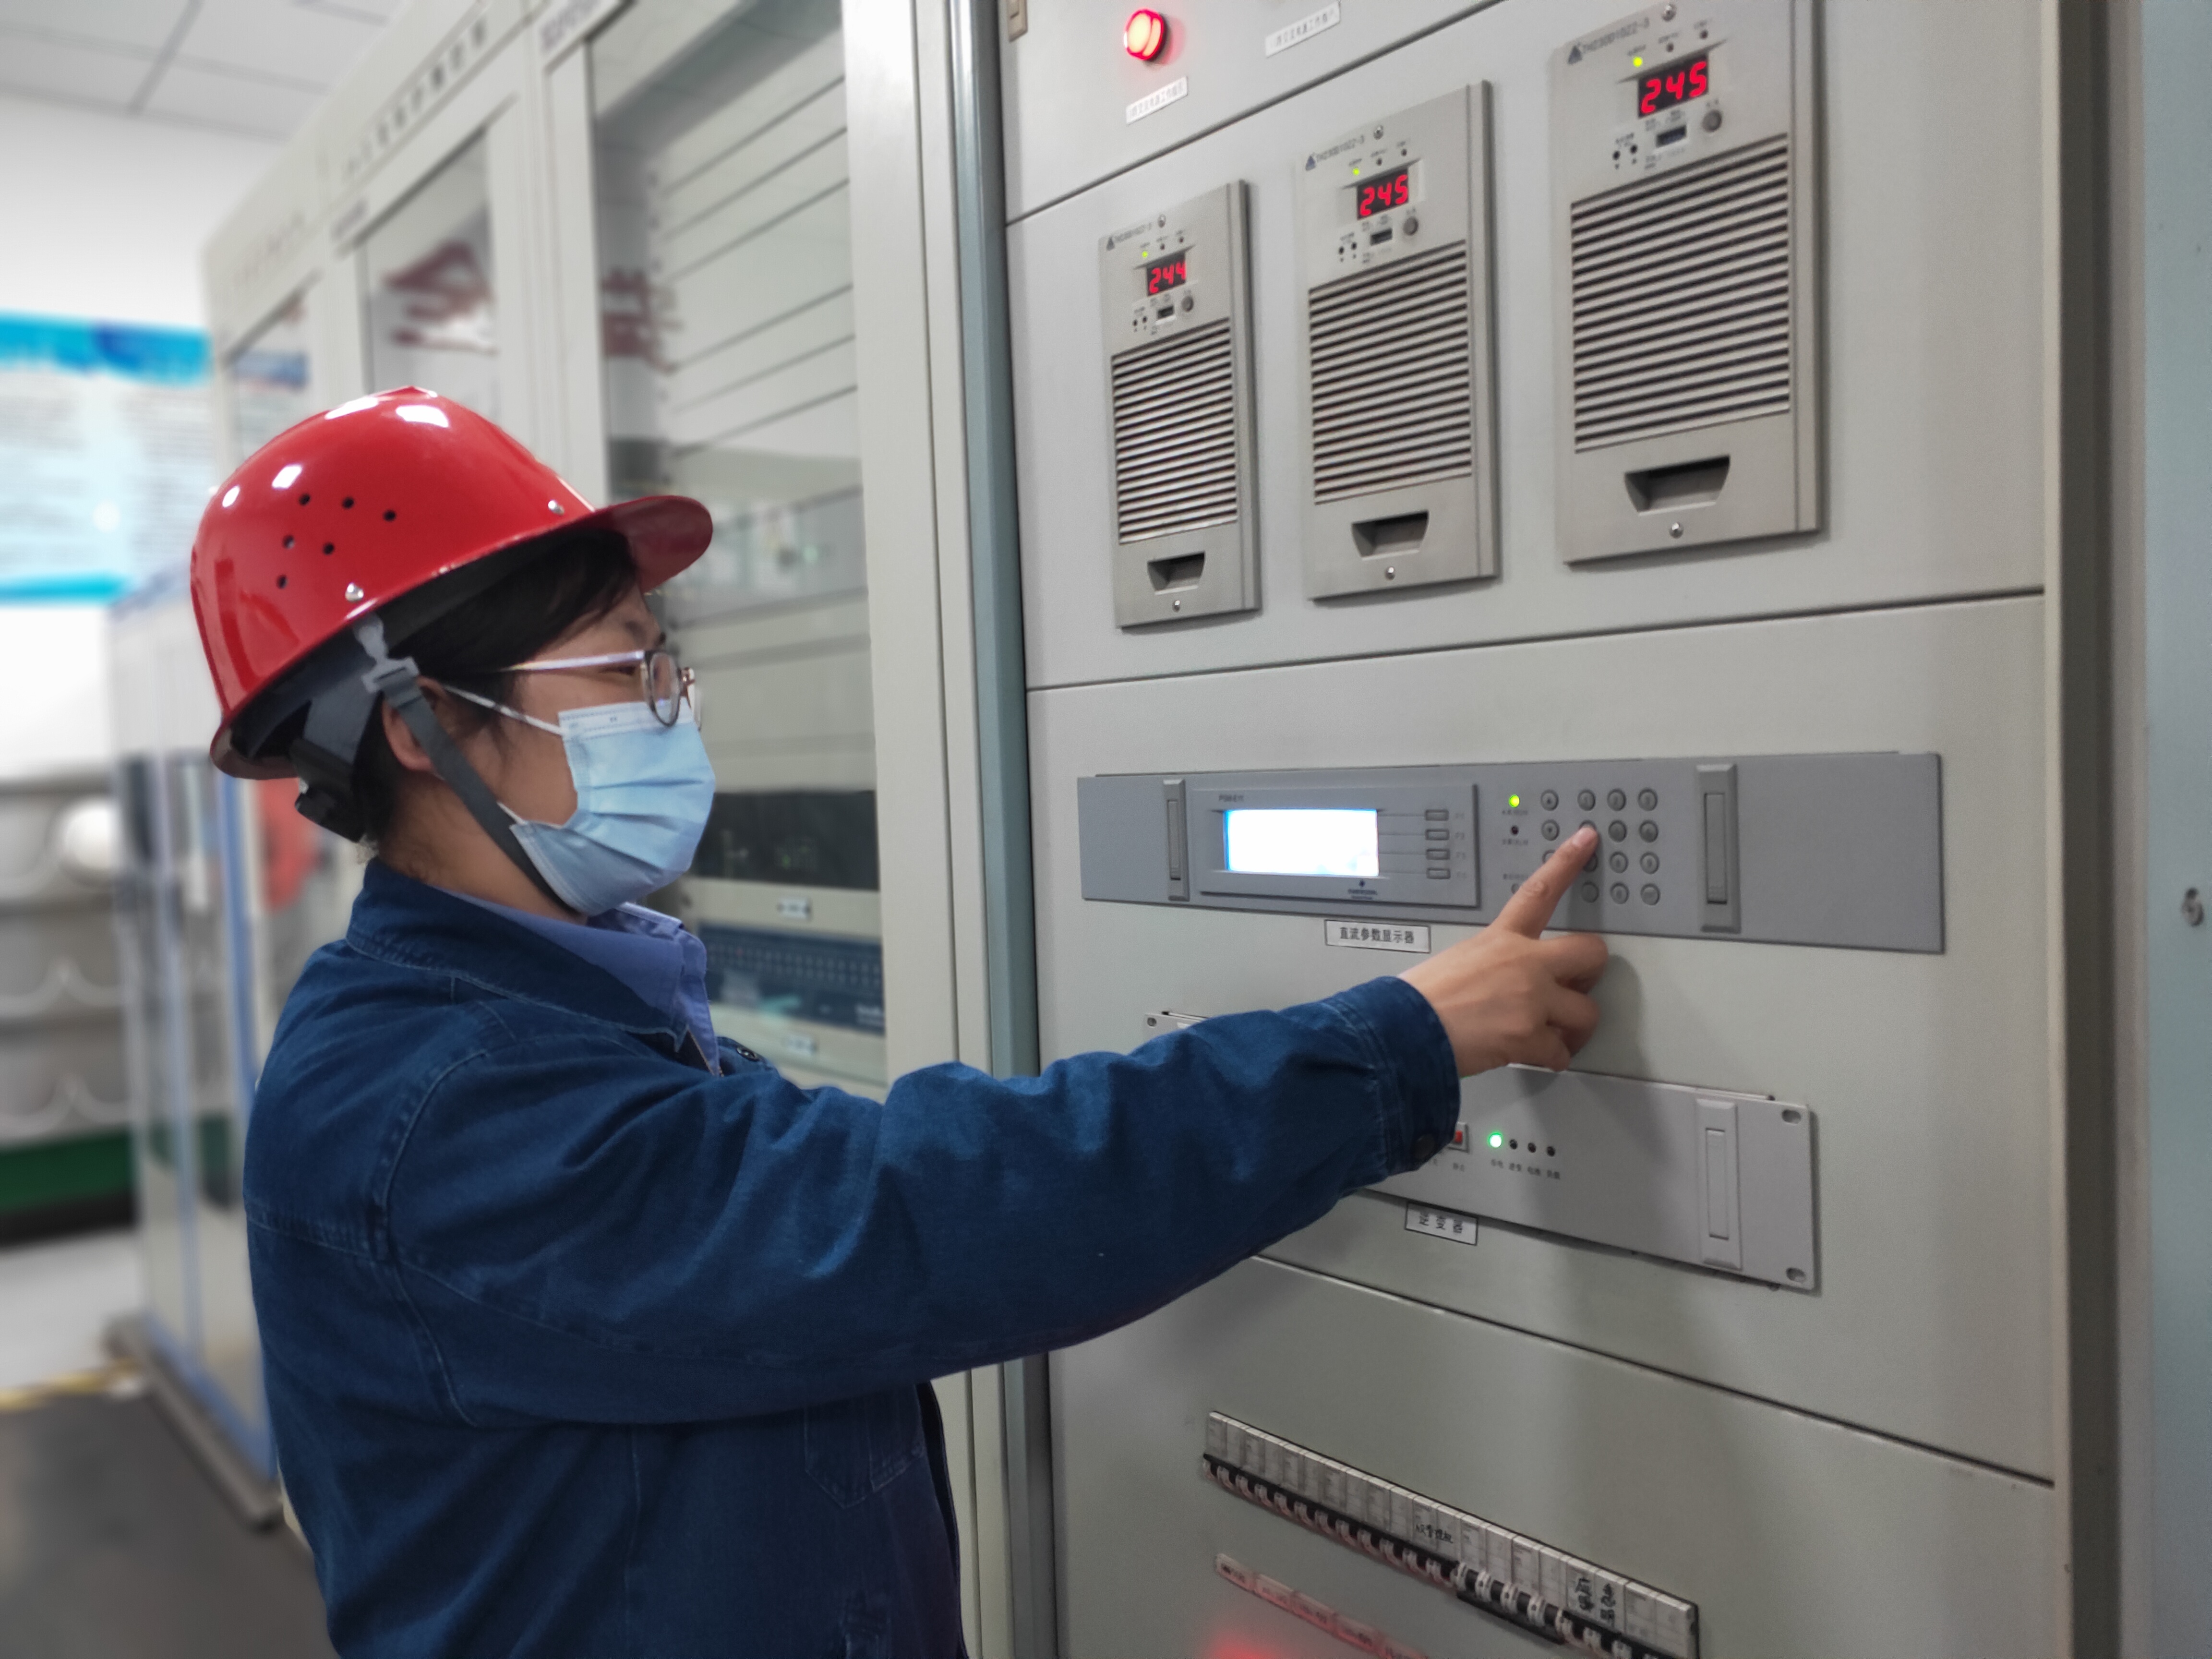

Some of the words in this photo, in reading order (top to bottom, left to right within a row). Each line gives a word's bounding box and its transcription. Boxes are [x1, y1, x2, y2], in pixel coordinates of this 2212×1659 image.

[1641, 60, 1707, 114] 245
[1360, 174, 1408, 216] 245
[1149, 261, 1187, 293] 244
[1340, 927, 1414, 943] 直流参数显示器
[1419, 1213, 1463, 1233] 逆变器
